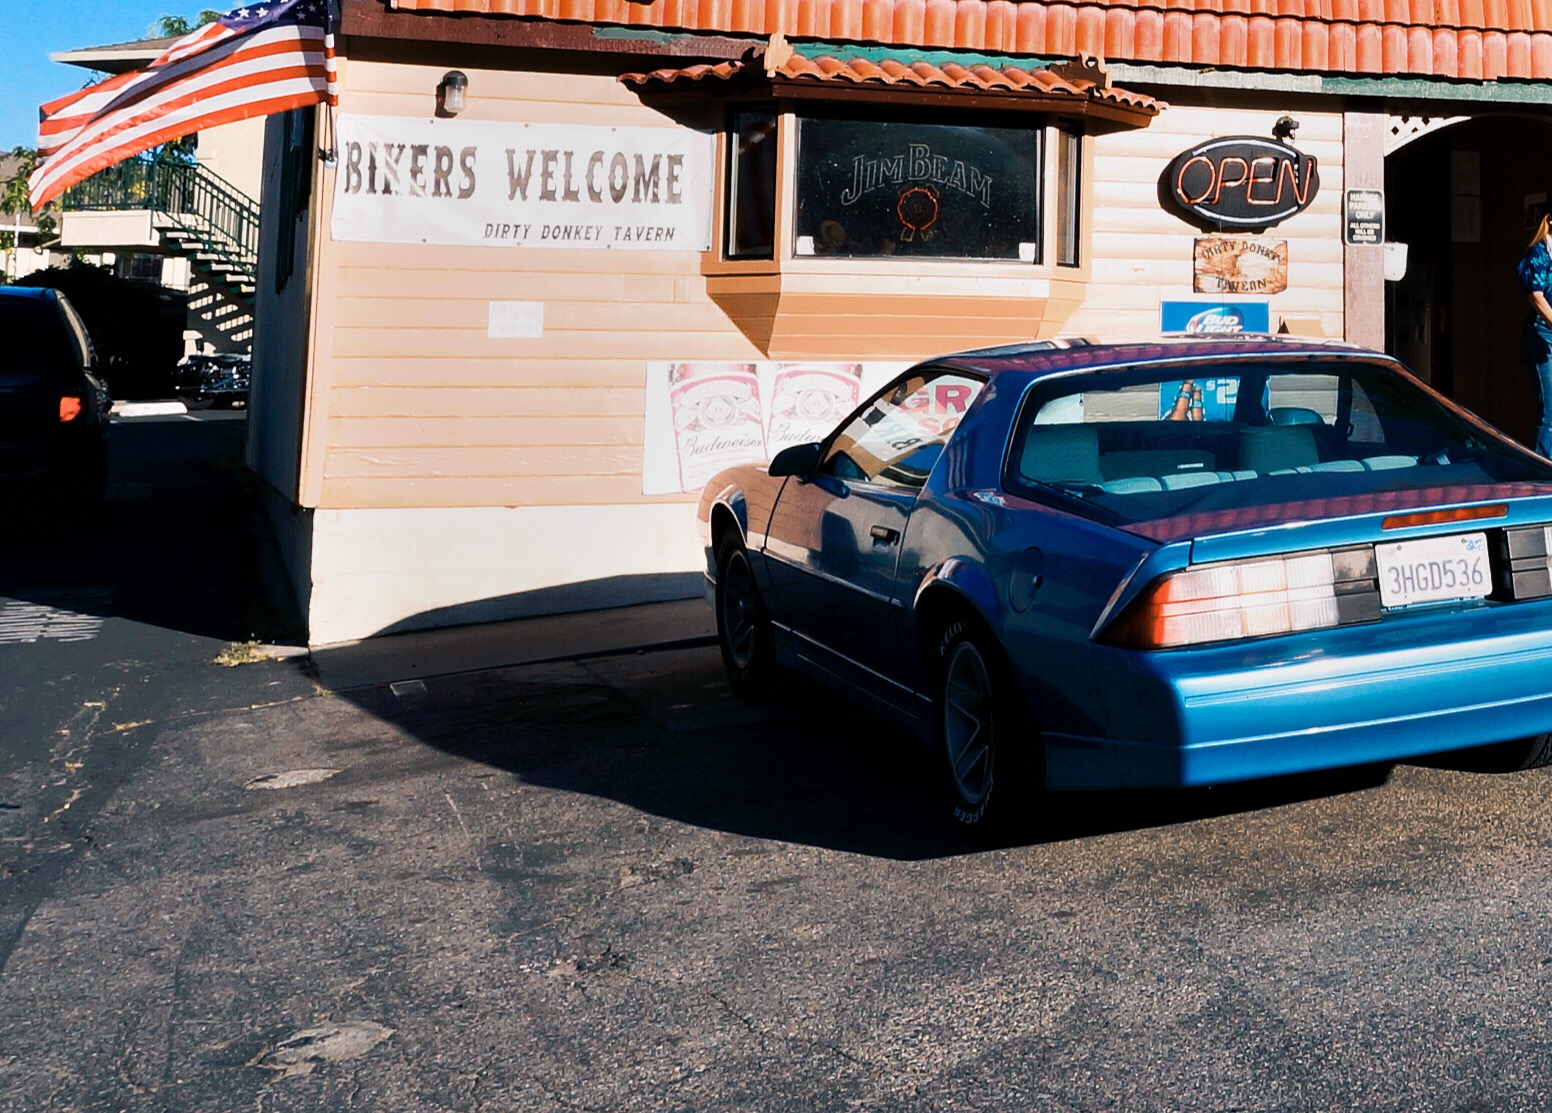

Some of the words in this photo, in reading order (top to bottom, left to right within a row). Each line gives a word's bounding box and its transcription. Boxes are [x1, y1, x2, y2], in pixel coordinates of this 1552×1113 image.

[344, 141, 477, 199] BIKERS
[505, 148, 685, 205] WELCOME
[841, 154, 905, 206] JIM
[908, 143, 993, 208] BEAM
[1177, 155, 1312, 205] OPEN
[1355, 211, 1375, 219] ONLY
[484, 223, 532, 239] DIRTY
[540, 224, 604, 241] DONKEY
[614, 226, 676, 242] TAVERN
[1202, 240, 1237, 260] DIRTY
[1215, 276, 1267, 292] TAVERN
[1202, 314, 1239, 326] BUD
[1206, 379, 1240, 405] $2
[685, 432, 763, 458] Budweiser
[1387, 555, 1484, 595] 3HGD536
